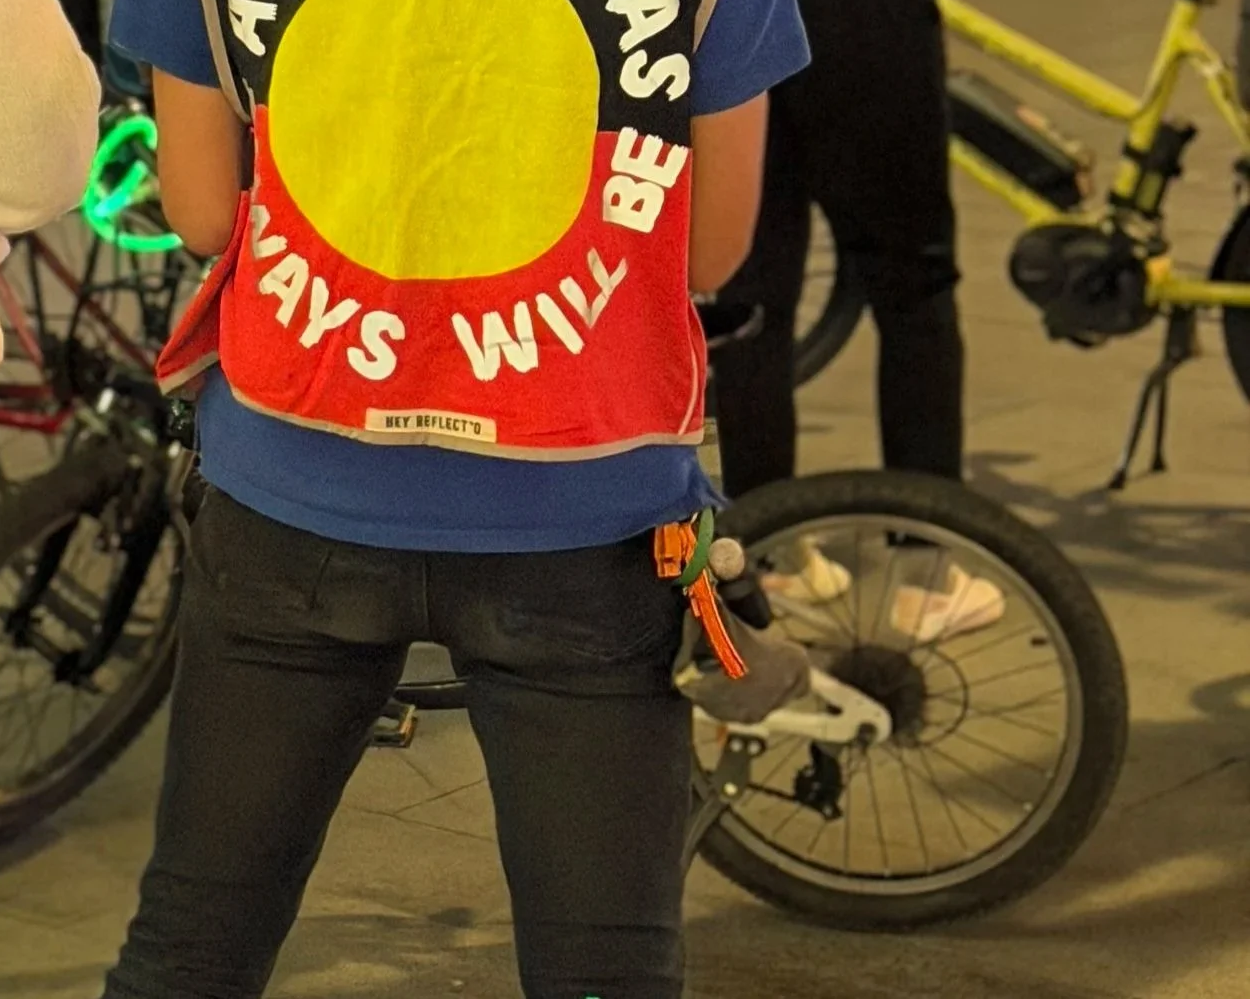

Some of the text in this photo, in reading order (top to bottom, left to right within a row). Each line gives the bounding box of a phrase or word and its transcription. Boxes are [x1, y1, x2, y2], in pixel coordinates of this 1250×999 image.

[451, 247, 627, 382] WILL
[602, 126, 689, 233] BE
[385, 415, 411, 429] HEY
